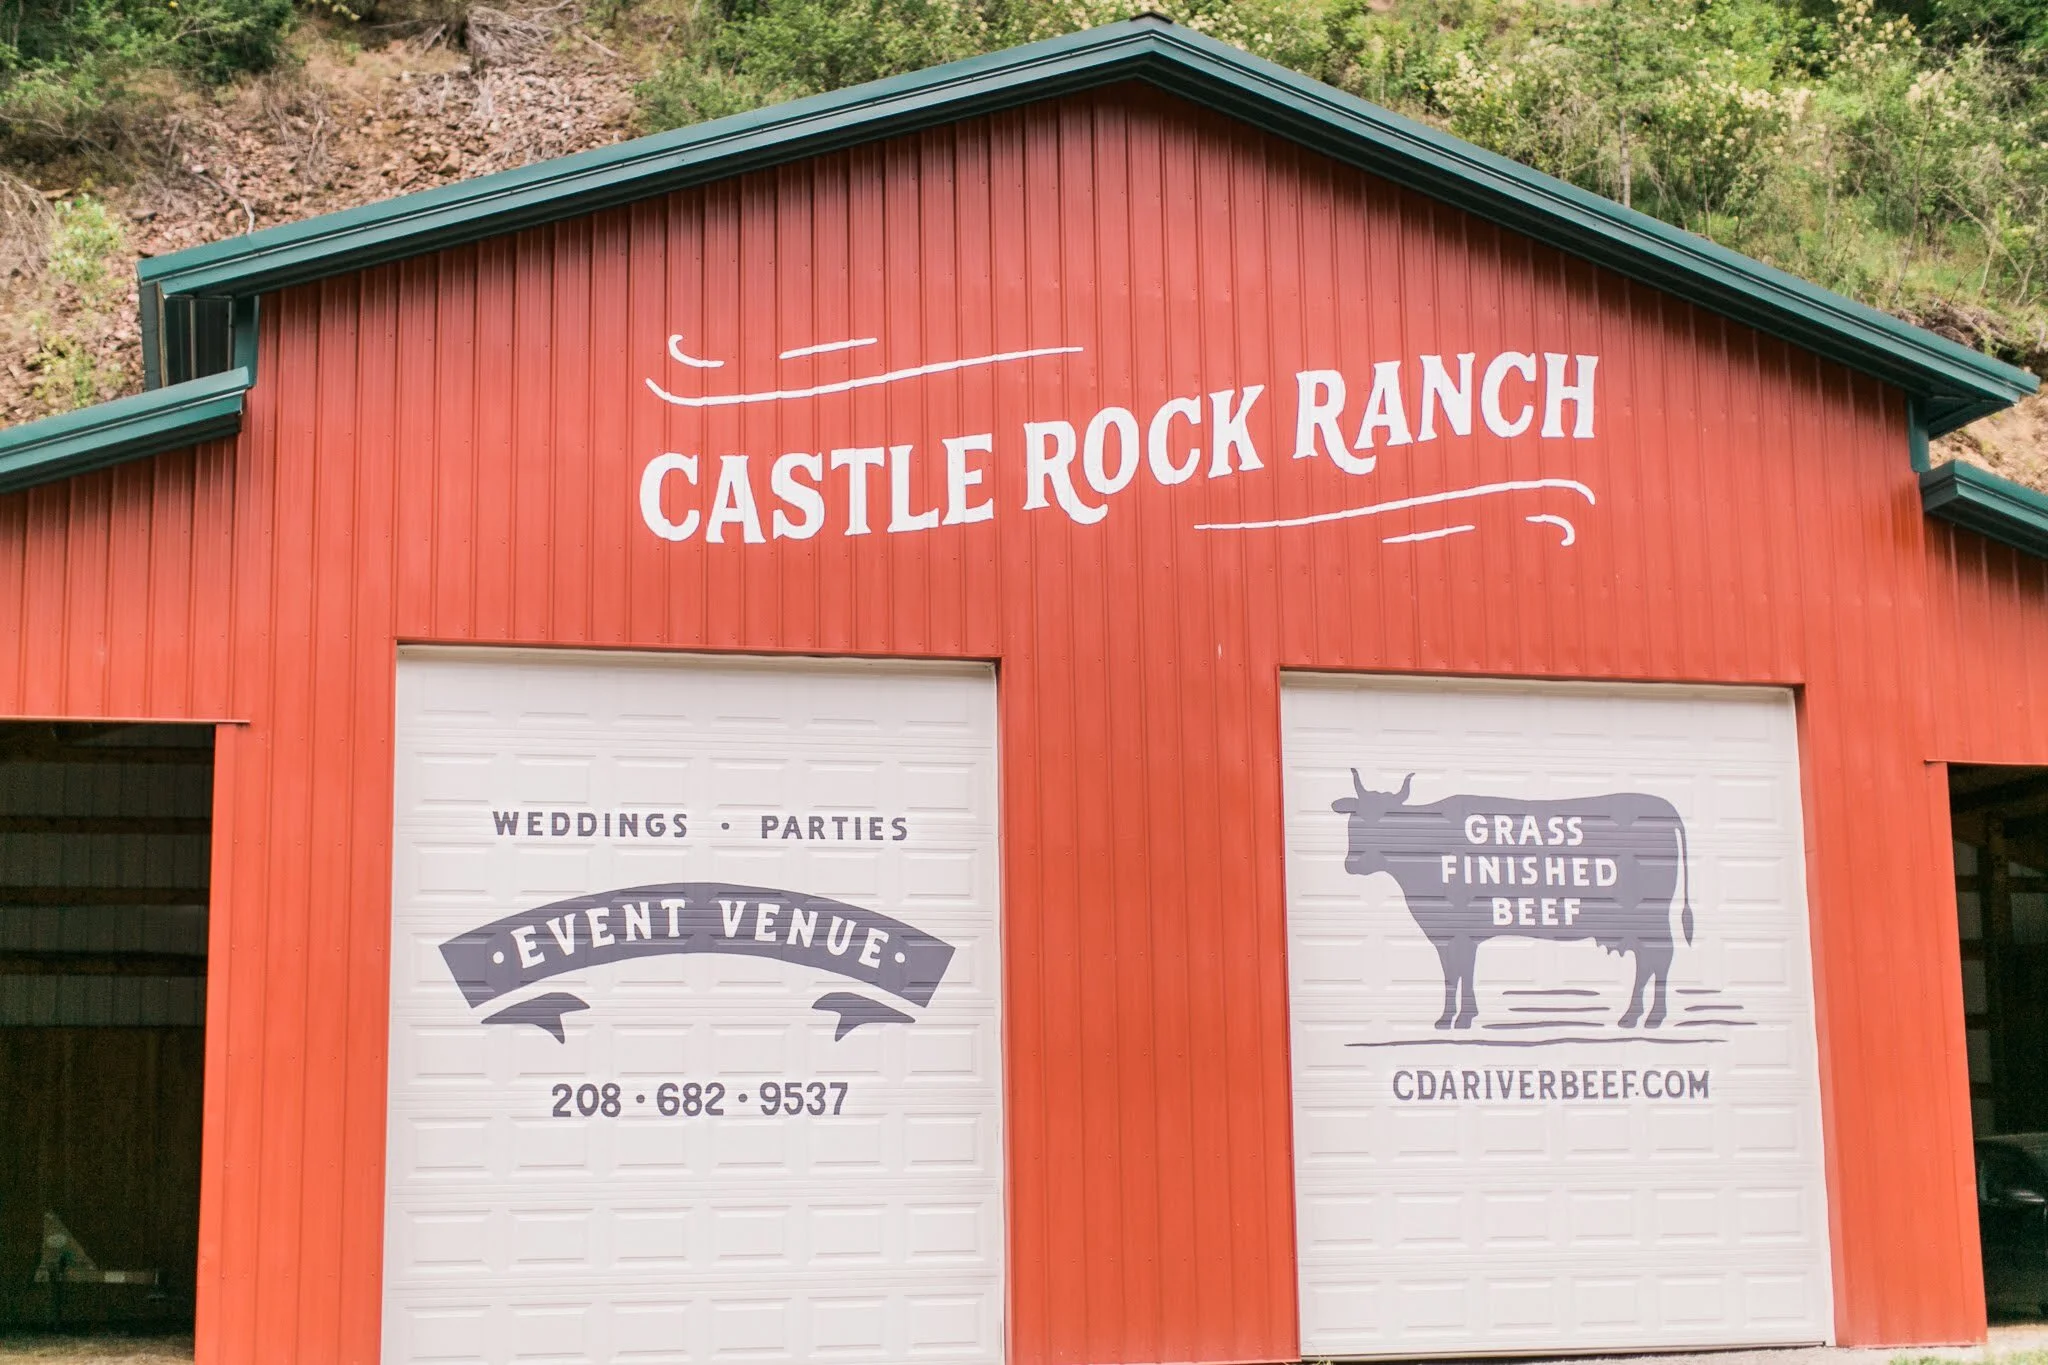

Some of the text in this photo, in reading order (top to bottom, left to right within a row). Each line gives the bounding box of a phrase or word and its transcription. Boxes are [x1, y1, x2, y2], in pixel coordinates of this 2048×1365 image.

[640, 352, 1598, 543] CASTLE ROCK RANCH
[493, 811, 907, 841] WEDDINGS PARTIES
[1465, 815, 1583, 845] GRASS
[1442, 855, 1617, 886] FINISHED
[1492, 898, 1580, 925] BEEF
[511, 899, 889, 969] EVENT VENUE
[1393, 1071, 1709, 1100] CDARIVERBEEF.COM
